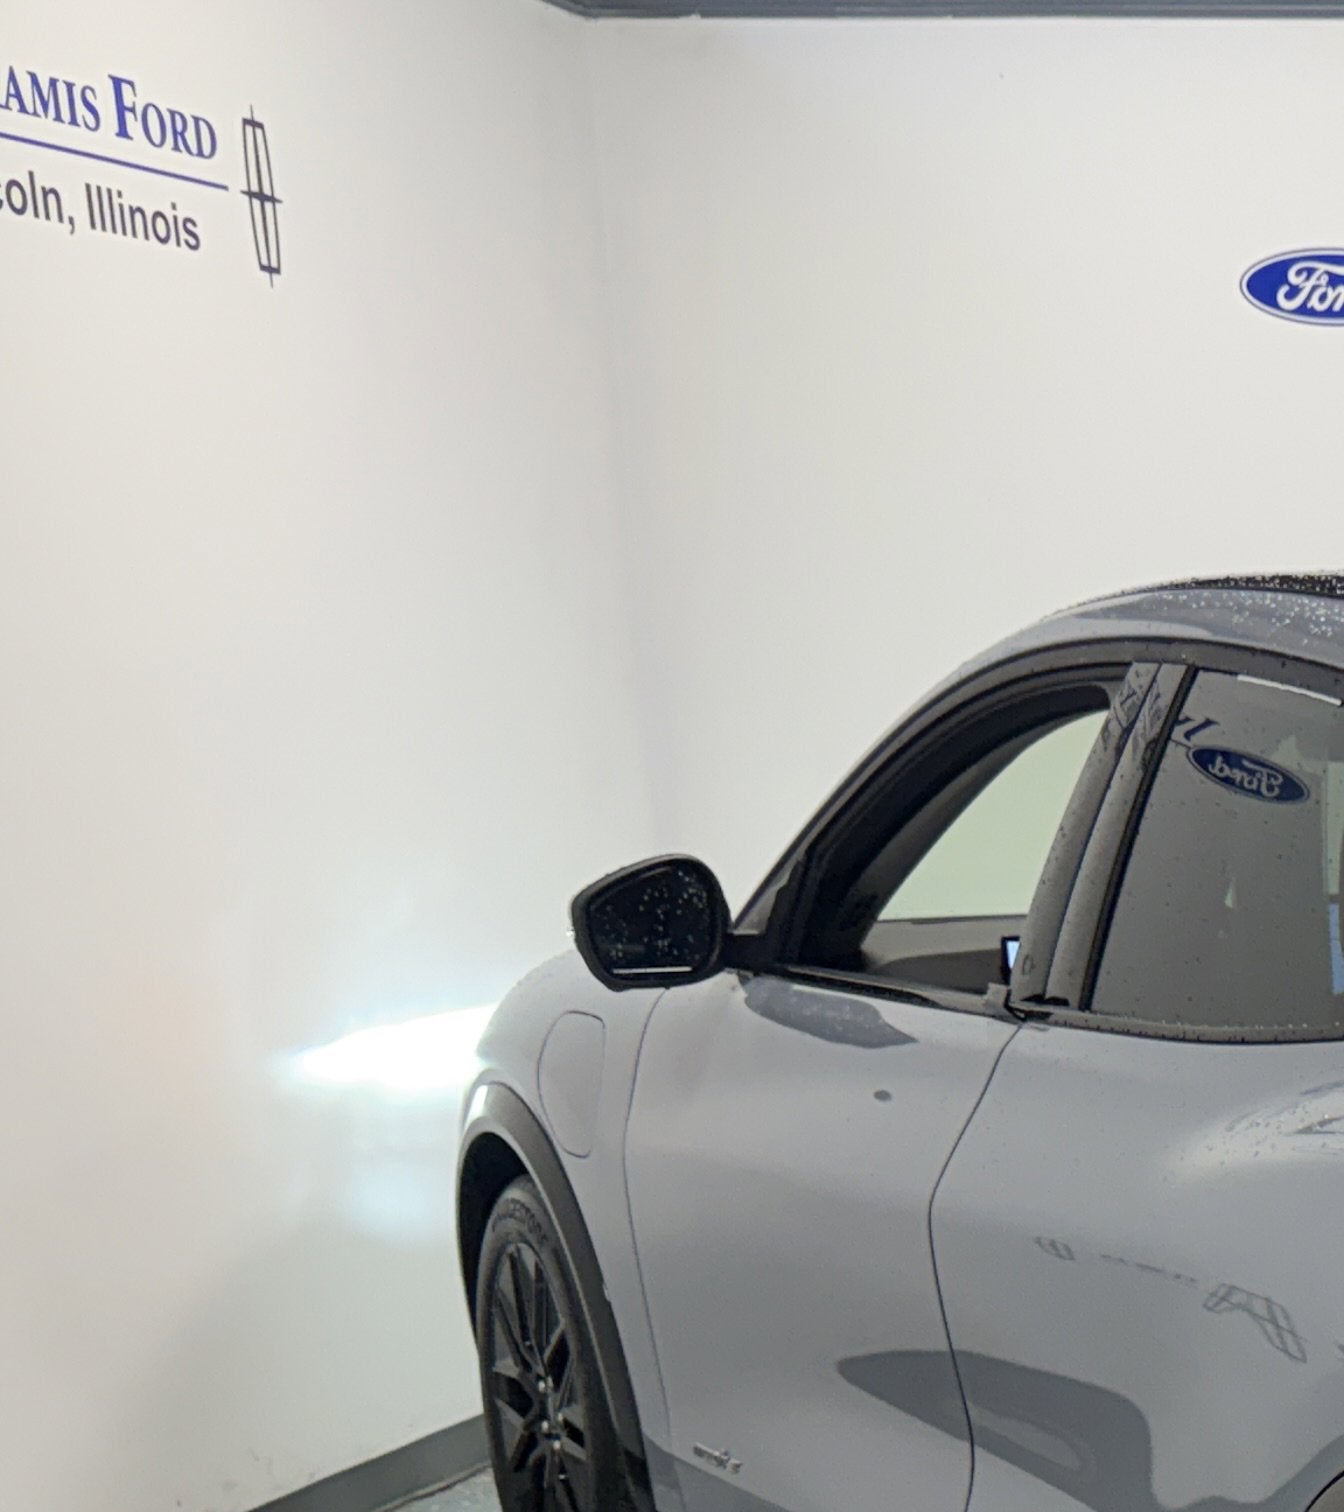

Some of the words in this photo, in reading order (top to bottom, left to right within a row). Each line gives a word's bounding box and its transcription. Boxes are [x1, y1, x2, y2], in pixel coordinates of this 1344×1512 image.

[0, 64, 101, 133] AMIS
[107, 73, 218, 160] FORD
[0, 169, 76, 236] oln,
[84, 181, 202, 252] Illinois
